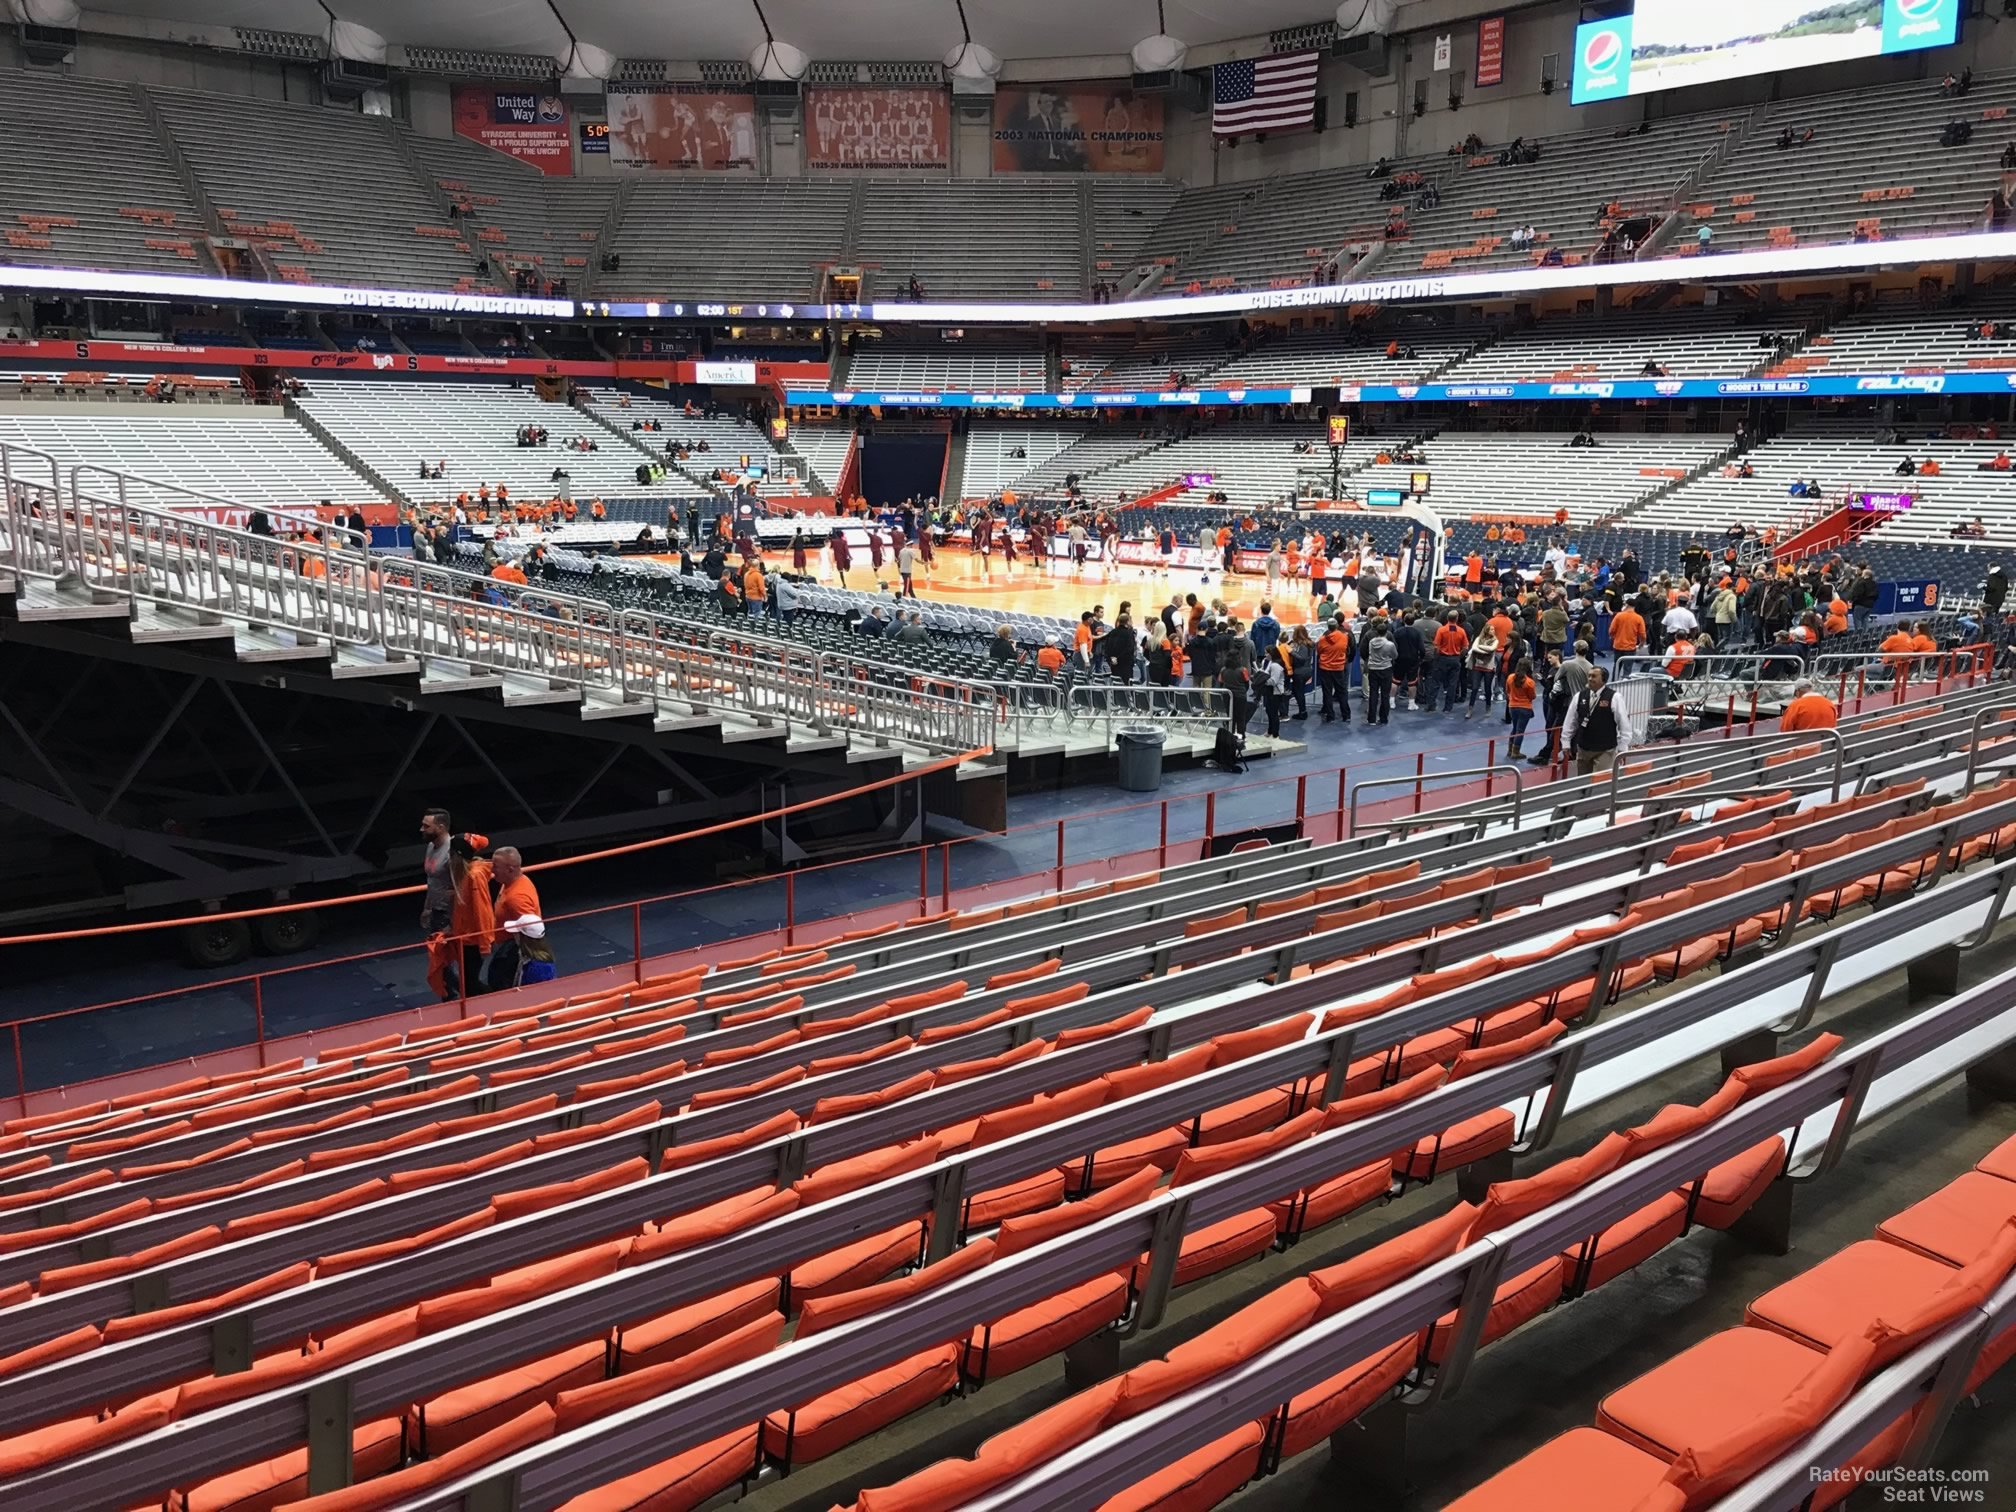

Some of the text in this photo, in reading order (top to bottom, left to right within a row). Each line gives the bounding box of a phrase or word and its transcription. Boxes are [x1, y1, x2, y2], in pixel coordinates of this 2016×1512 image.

[607, 86, 674, 95] BASKETBALL
[678, 86, 705, 95] HALL
[497, 96, 535, 108] United
[512, 108, 535, 122] Way
[995, 131, 1163, 141] 2003 NATIONAL CHAMPIONS
[1250, 281, 1445, 310] CUSE.COM/AUCTIONS
[727, 306, 743, 316] 1ST
[1726, 383, 1758, 391] MOORE'S
[1760, 383, 1776, 391] TIRE
[1778, 382, 1801, 391] SALES
[1331, 428, 1345, 443] 30
[1924, 584, 1938, 606] S
